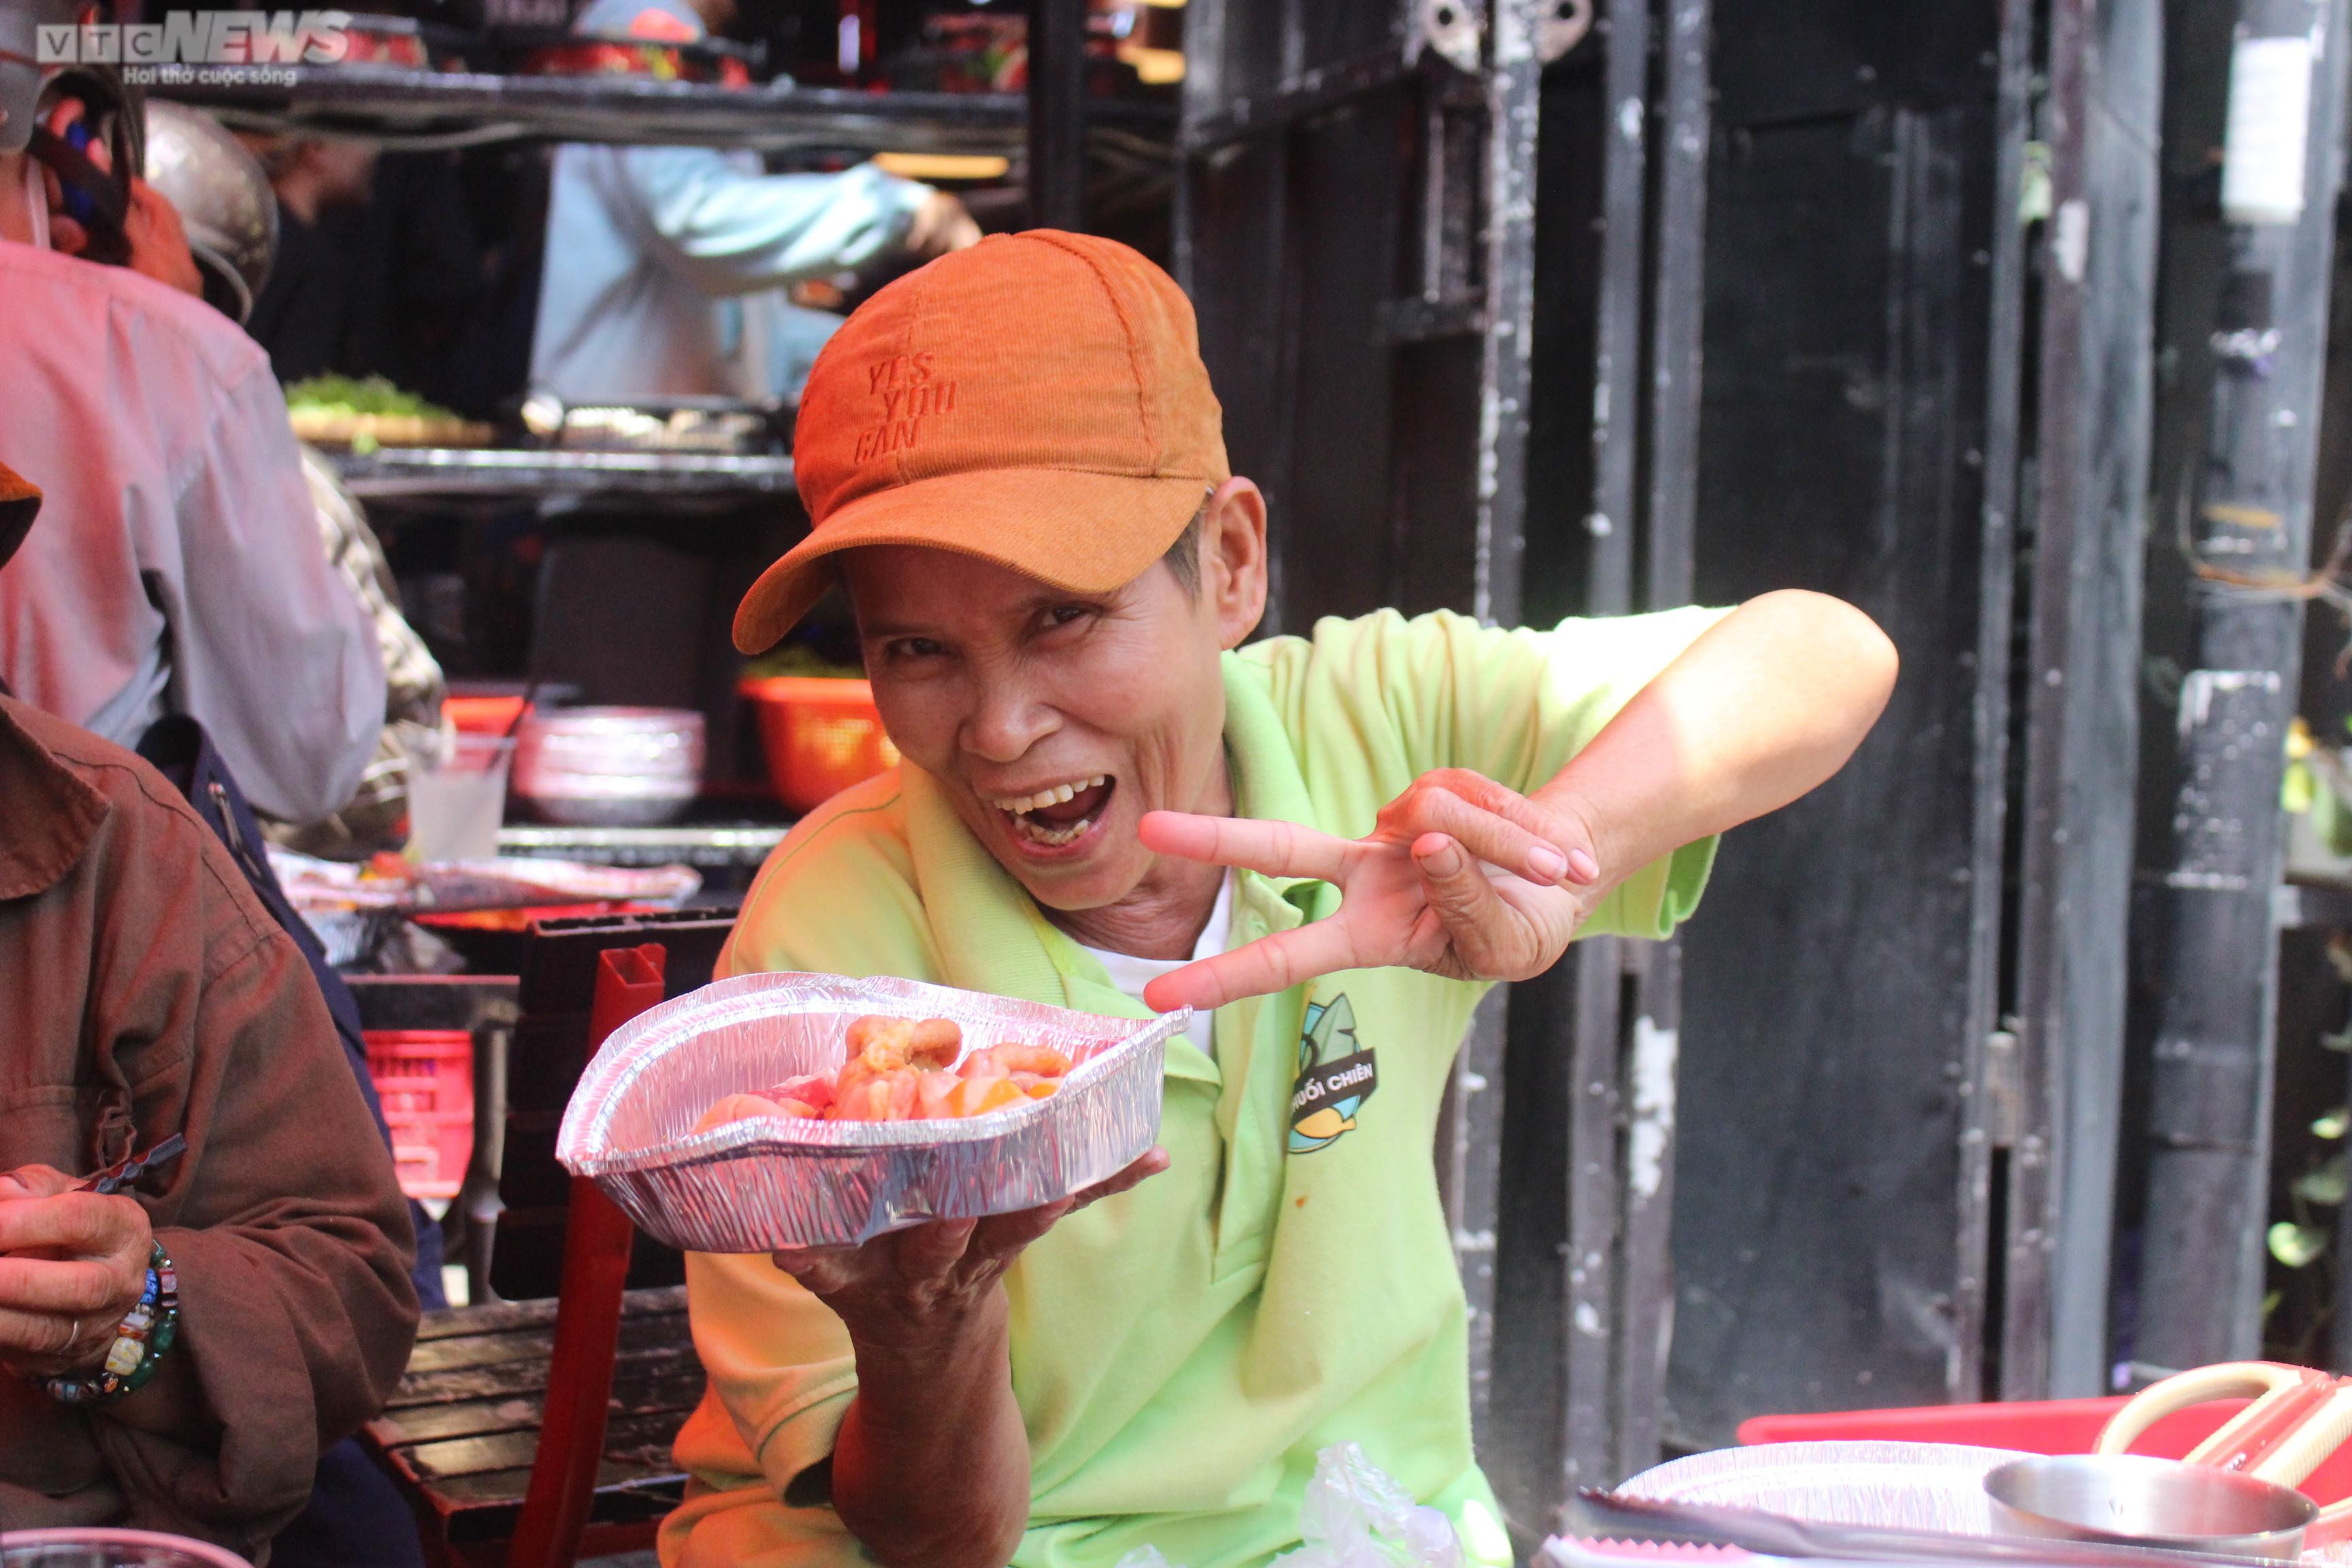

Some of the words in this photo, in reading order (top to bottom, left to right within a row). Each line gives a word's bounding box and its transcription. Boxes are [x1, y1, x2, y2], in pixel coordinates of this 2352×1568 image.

[870, 352, 934, 395] YES
[885, 381, 957, 422] YOU
[855, 418, 921, 464] CAN
[1292, 1077, 1326, 1111] HUỐI
[1326, 1063, 1373, 1091] CHIÊN
